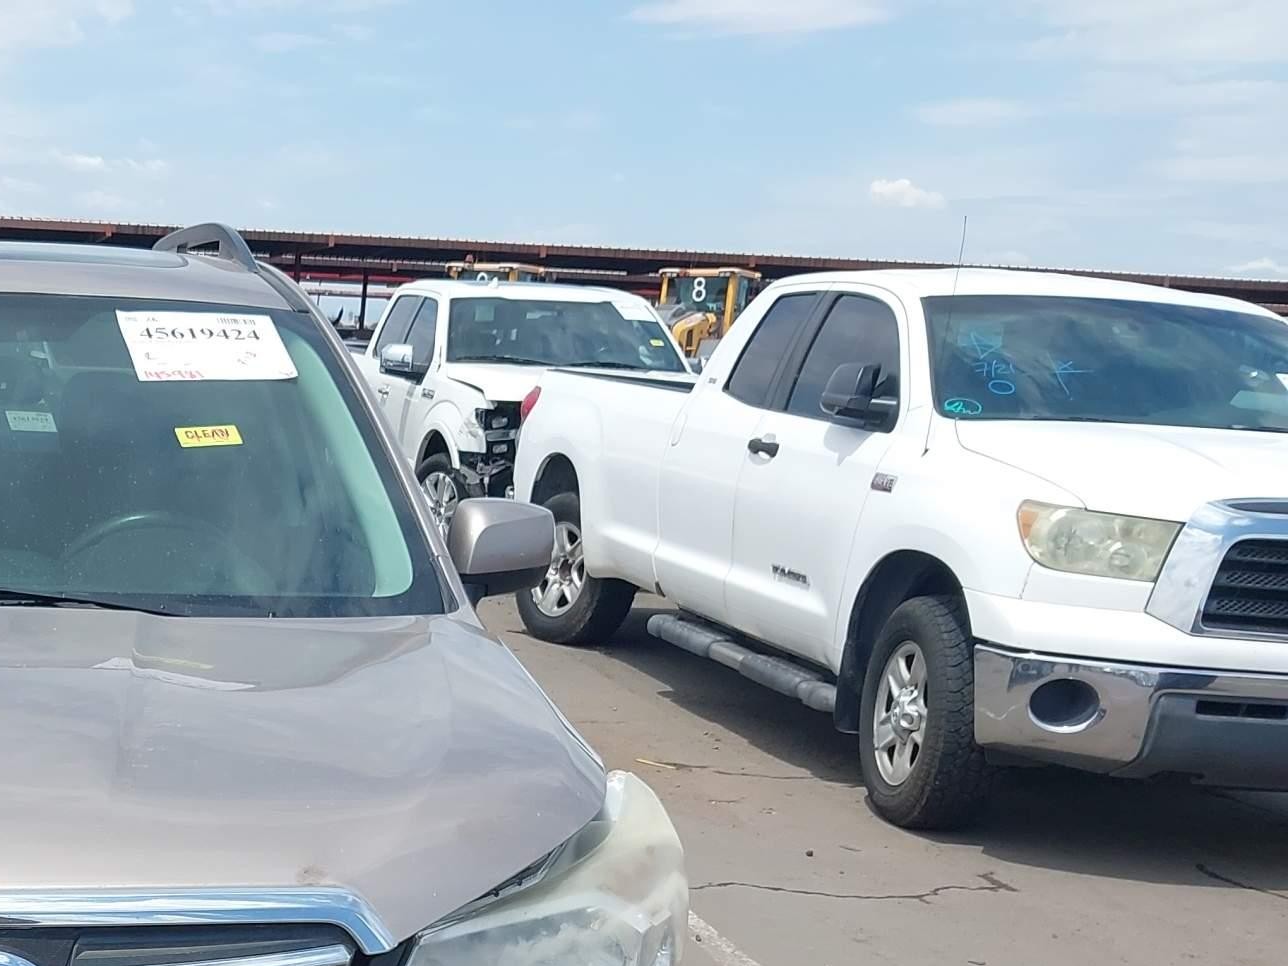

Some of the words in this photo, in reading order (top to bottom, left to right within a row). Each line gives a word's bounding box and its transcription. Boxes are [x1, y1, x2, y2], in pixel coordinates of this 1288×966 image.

[692, 276, 706, 302] 8
[140, 327, 261, 341] 45619424
[185, 428, 230, 440] CLEAN
